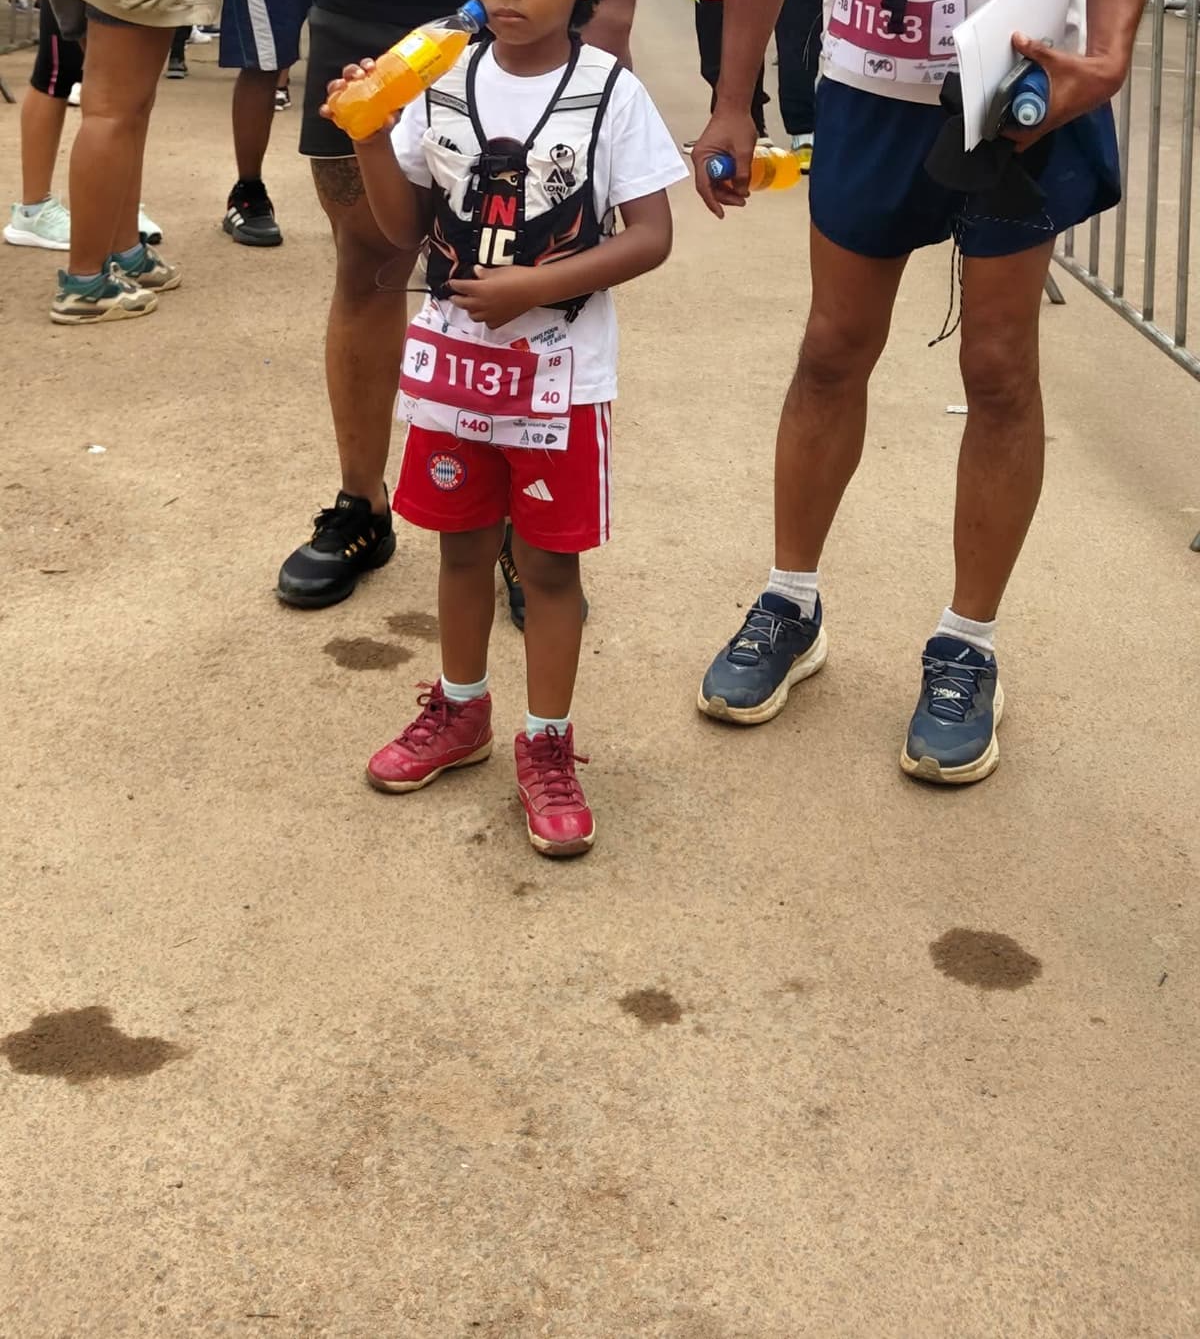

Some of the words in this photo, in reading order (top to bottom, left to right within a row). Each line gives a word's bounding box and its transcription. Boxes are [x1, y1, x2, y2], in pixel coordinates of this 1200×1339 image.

[941, 2, 955, 15] 18
[410, 350, 429, 367] -18
[548, 355, 562, 368] 18
[445, 352, 522, 397] 1131
[540, 391, 560, 404] 40
[460, 418, 489, 433] +40
